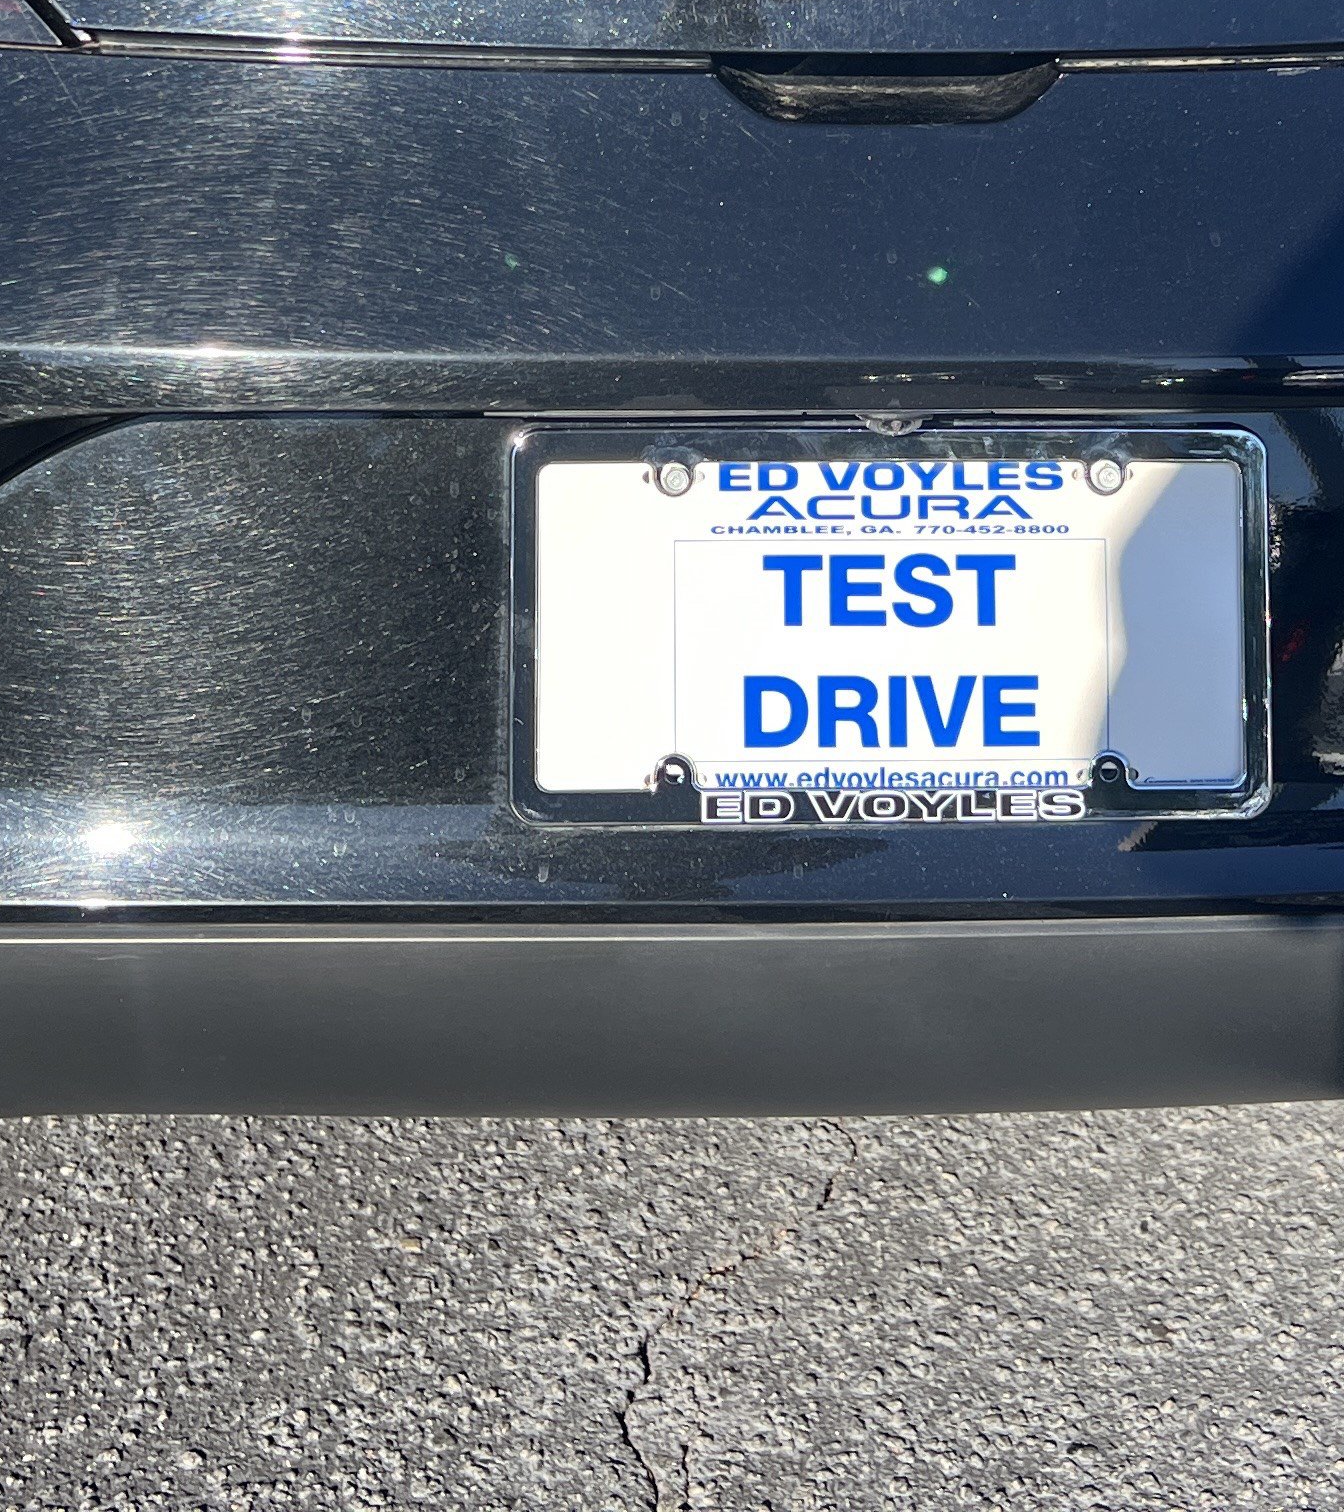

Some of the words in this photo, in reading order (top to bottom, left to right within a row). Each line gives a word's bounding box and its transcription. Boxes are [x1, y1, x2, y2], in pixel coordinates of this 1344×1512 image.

[719, 462, 798, 491] ED
[817, 461, 1064, 491] VOYLES
[746, 494, 1034, 521] ACURA
[710, 525, 852, 536] CHAMBLEE,
[860, 525, 902, 535] GA.
[914, 524, 1070, 535] 770-452-8800
[763, 553, 1016, 627] TEST
[743, 674, 1041, 749] DRIVE
[714, 766, 1069, 788] www.edvoylesacura.com
[700, 790, 795, 823] ED
[805, 789, 1087, 823] VOYLES
